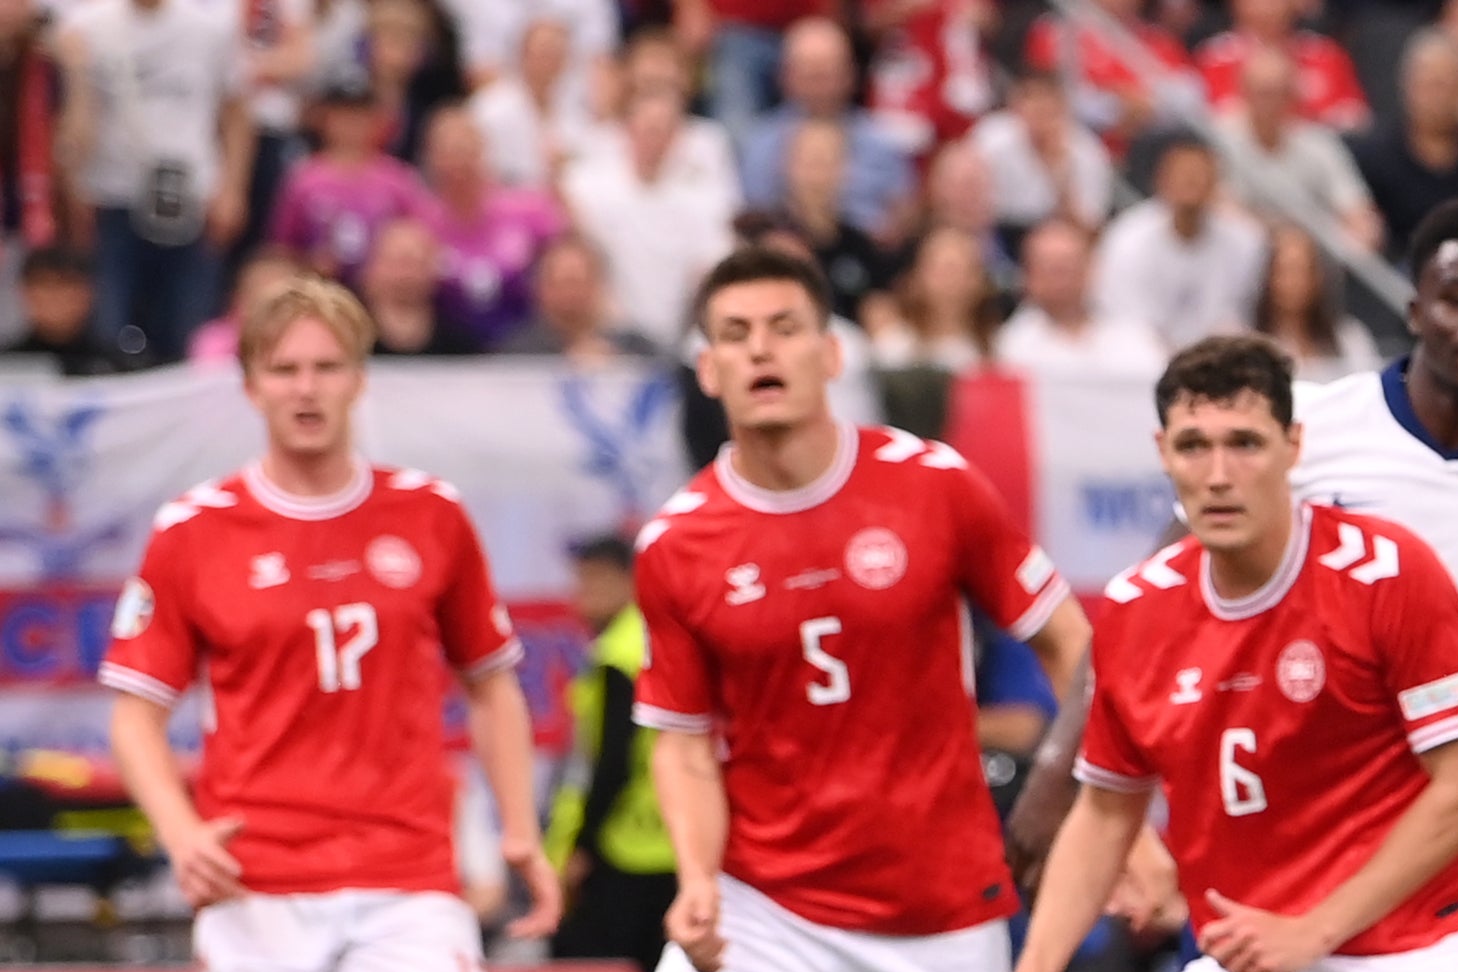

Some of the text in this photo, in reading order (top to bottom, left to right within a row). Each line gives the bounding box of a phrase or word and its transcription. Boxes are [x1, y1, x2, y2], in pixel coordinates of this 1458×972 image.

[305, 602, 379, 693] 17
[800, 616, 850, 706] 5
[1220, 727, 1268, 817] 6
